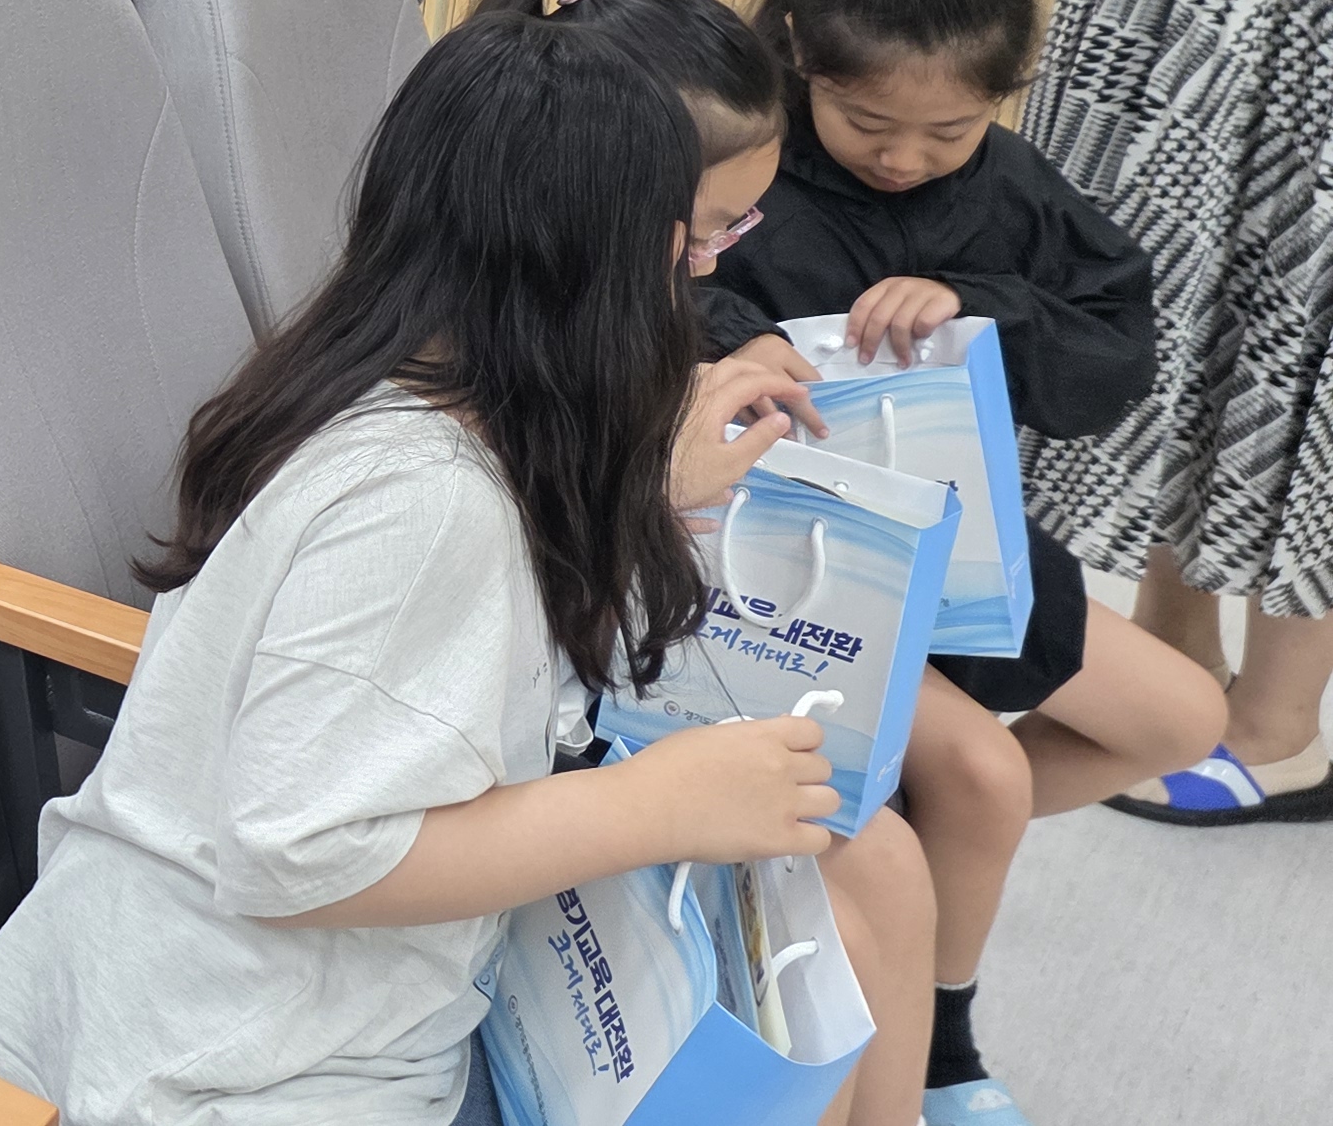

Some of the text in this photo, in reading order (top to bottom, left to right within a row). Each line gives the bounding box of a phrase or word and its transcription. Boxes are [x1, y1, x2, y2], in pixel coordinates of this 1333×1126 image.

[738, 639, 830, 681] 제대로!
[547, 928, 583, 990] 크게
[594, 989, 635, 1084] 대전환
